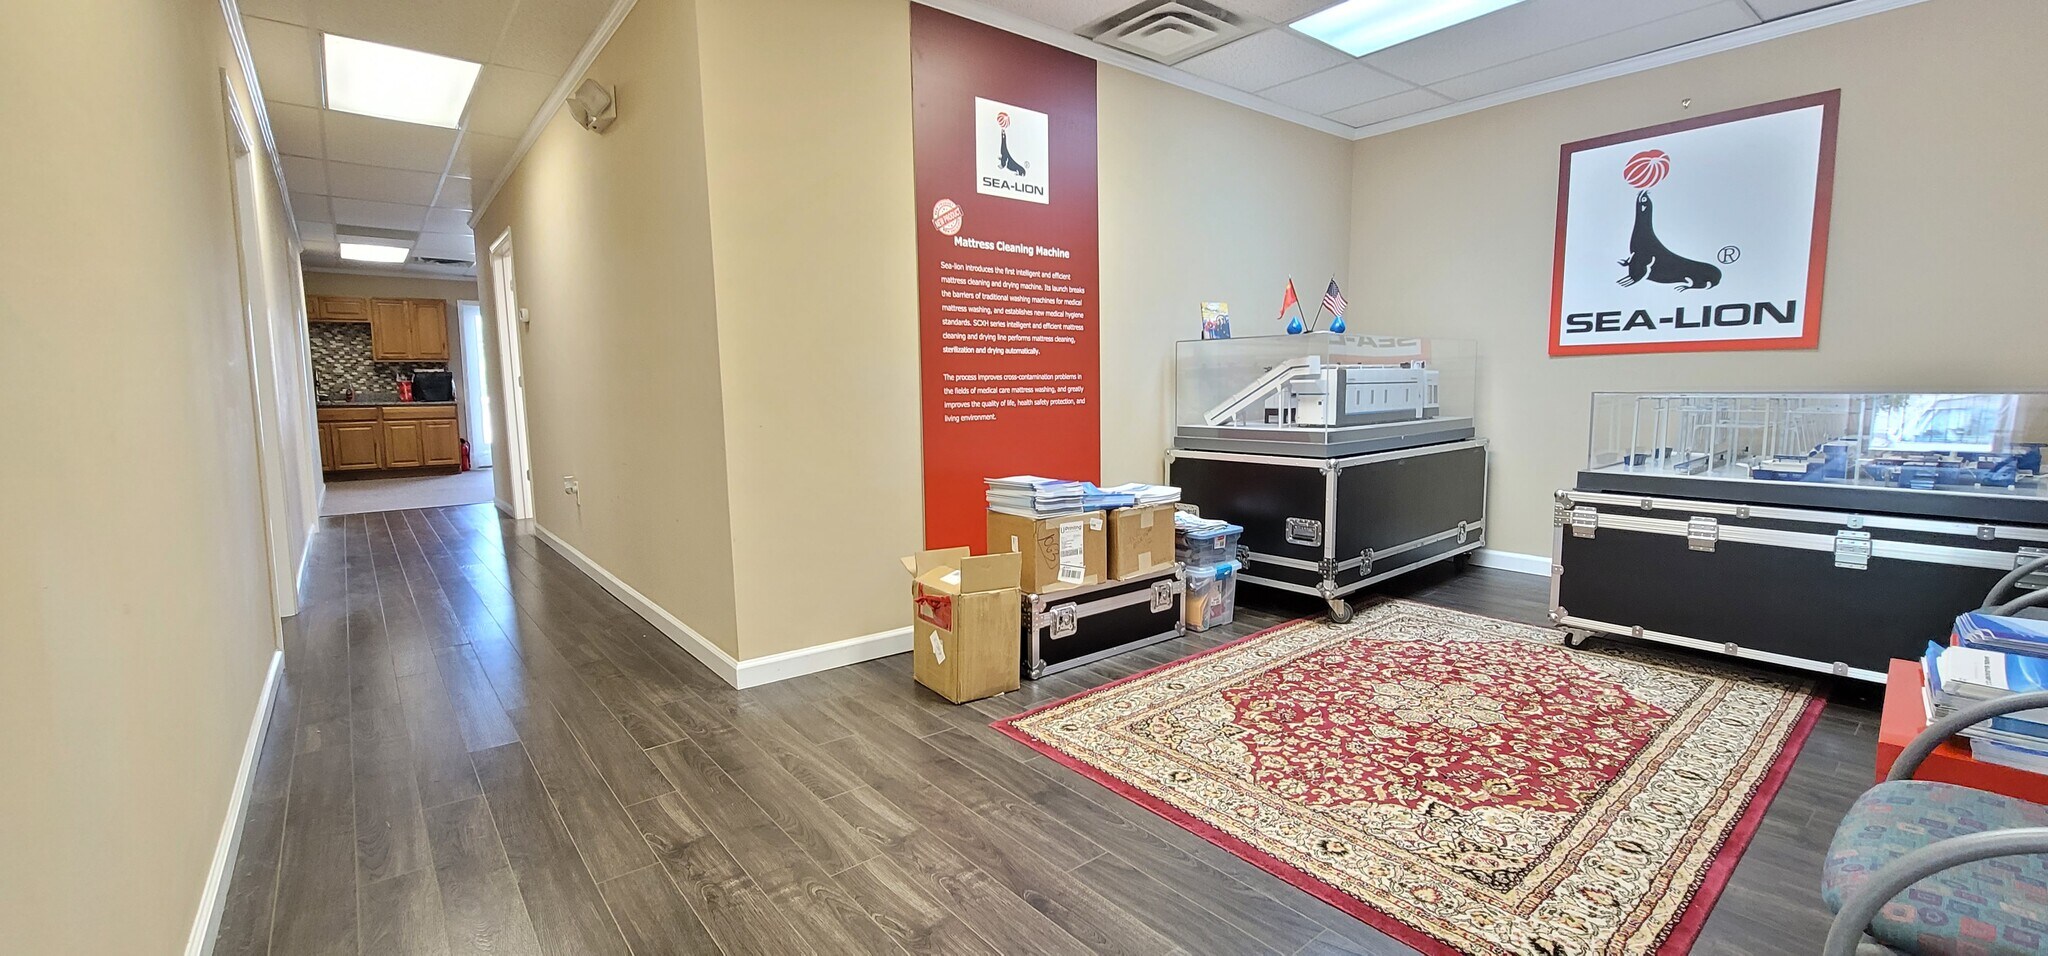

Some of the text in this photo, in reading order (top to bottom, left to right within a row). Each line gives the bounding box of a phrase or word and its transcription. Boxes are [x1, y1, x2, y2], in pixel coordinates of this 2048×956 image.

[982, 176, 1044, 196] SEA-LION
[954, 236, 1070, 259] Mattress Cleaning Machine
[965, 264, 994, 273] introduces
[994, 266, 1004, 274] the
[1004, 267, 1015, 275] first
[1016, 269, 1041, 278] intelligent
[1052, 272, 1071, 280] efficient
[941, 276, 967, 285] mattress
[967, 278, 990, 288] cleaning
[1002, 281, 1019, 290] drying
[1020, 283, 1043, 291] machine.
[1052, 284, 1068, 292] launch
[1069, 286, 1085, 294] breaks
[941, 289, 951, 298] the
[952, 290, 974, 299] barriers
[982, 293, 1009, 301] traditional
[1009, 295, 1031, 304] washing
[942, 304, 967, 312] mattress
[968, 306, 992, 315] washing,
[1005, 308, 1033, 316] establishes
[1065, 311, 1084, 319] hygiene
[1565, 300, 1797, 334] SEA-LION
[942, 318, 972, 326] standards.
[1006, 321, 1031, 330] intelligent
[1043, 322, 1062, 330] efficient
[942, 332, 966, 341] cleaning
[979, 333, 996, 342] drying
[997, 333, 1007, 341] line
[1007, 334, 1031, 342] performs
[975, 346, 986, 354] and
[987, 346, 1004, 355] drying
[943, 373, 955, 381] The
[978, 373, 1003, 382] improves
[1054, 373, 1077, 381] problems
[943, 387, 954, 395] the
[1034, 386, 1056, 394] washing,
[944, 401, 970, 409] improves
[971, 400, 981, 408] the
[981, 400, 1000, 408] quality
[1000, 399, 1006, 407] of
[944, 415, 960, 423] living
